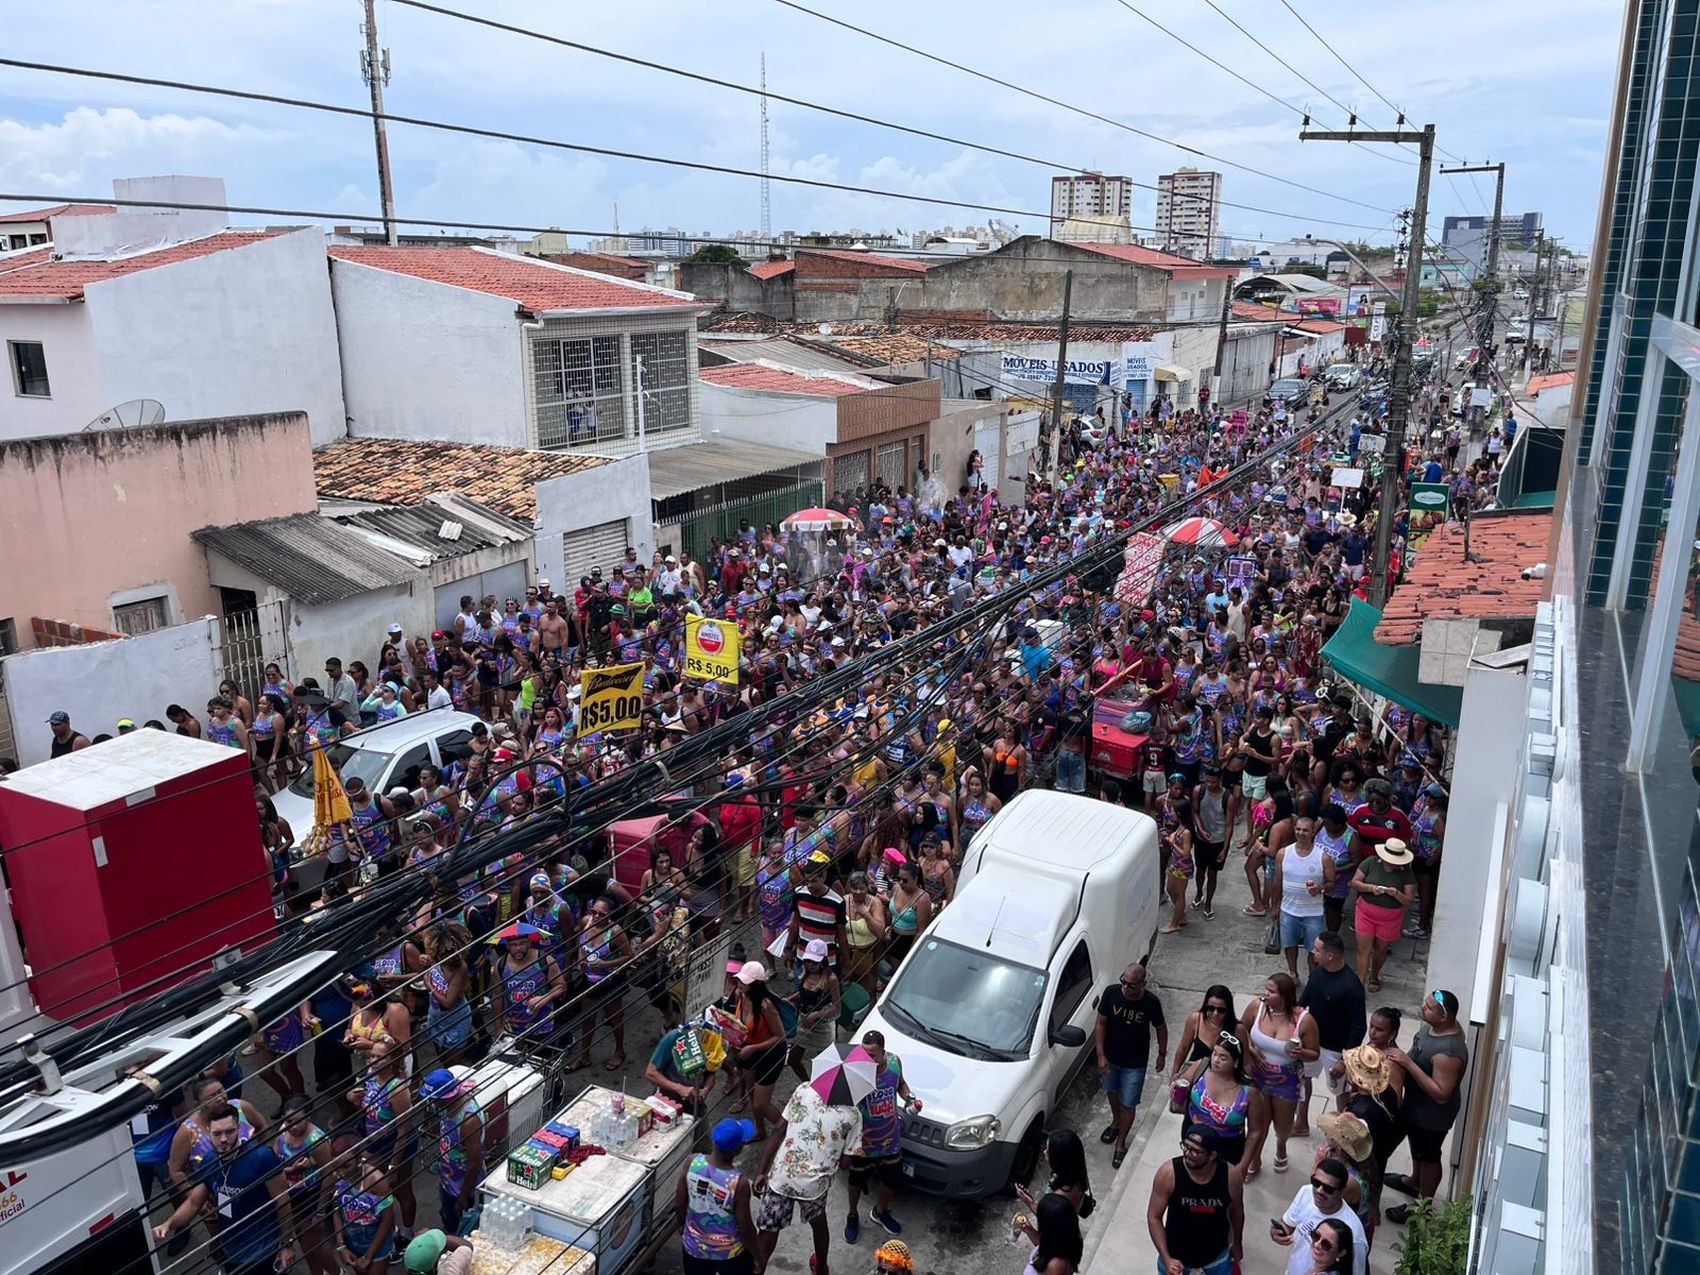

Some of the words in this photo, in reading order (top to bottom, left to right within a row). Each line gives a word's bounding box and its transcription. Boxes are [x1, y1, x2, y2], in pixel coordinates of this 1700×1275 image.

[687, 658, 703, 672] R$
[705, 661, 729, 678] 5,00
[589, 674, 635, 691] Budweiser
[580, 696, 641, 731] R$5,00
[1150, 752, 1158, 766] 9
[1112, 1004, 1145, 1021] VIBE
[687, 1029, 702, 1056] Hein
[1181, 1197, 1223, 1207] PRADA
